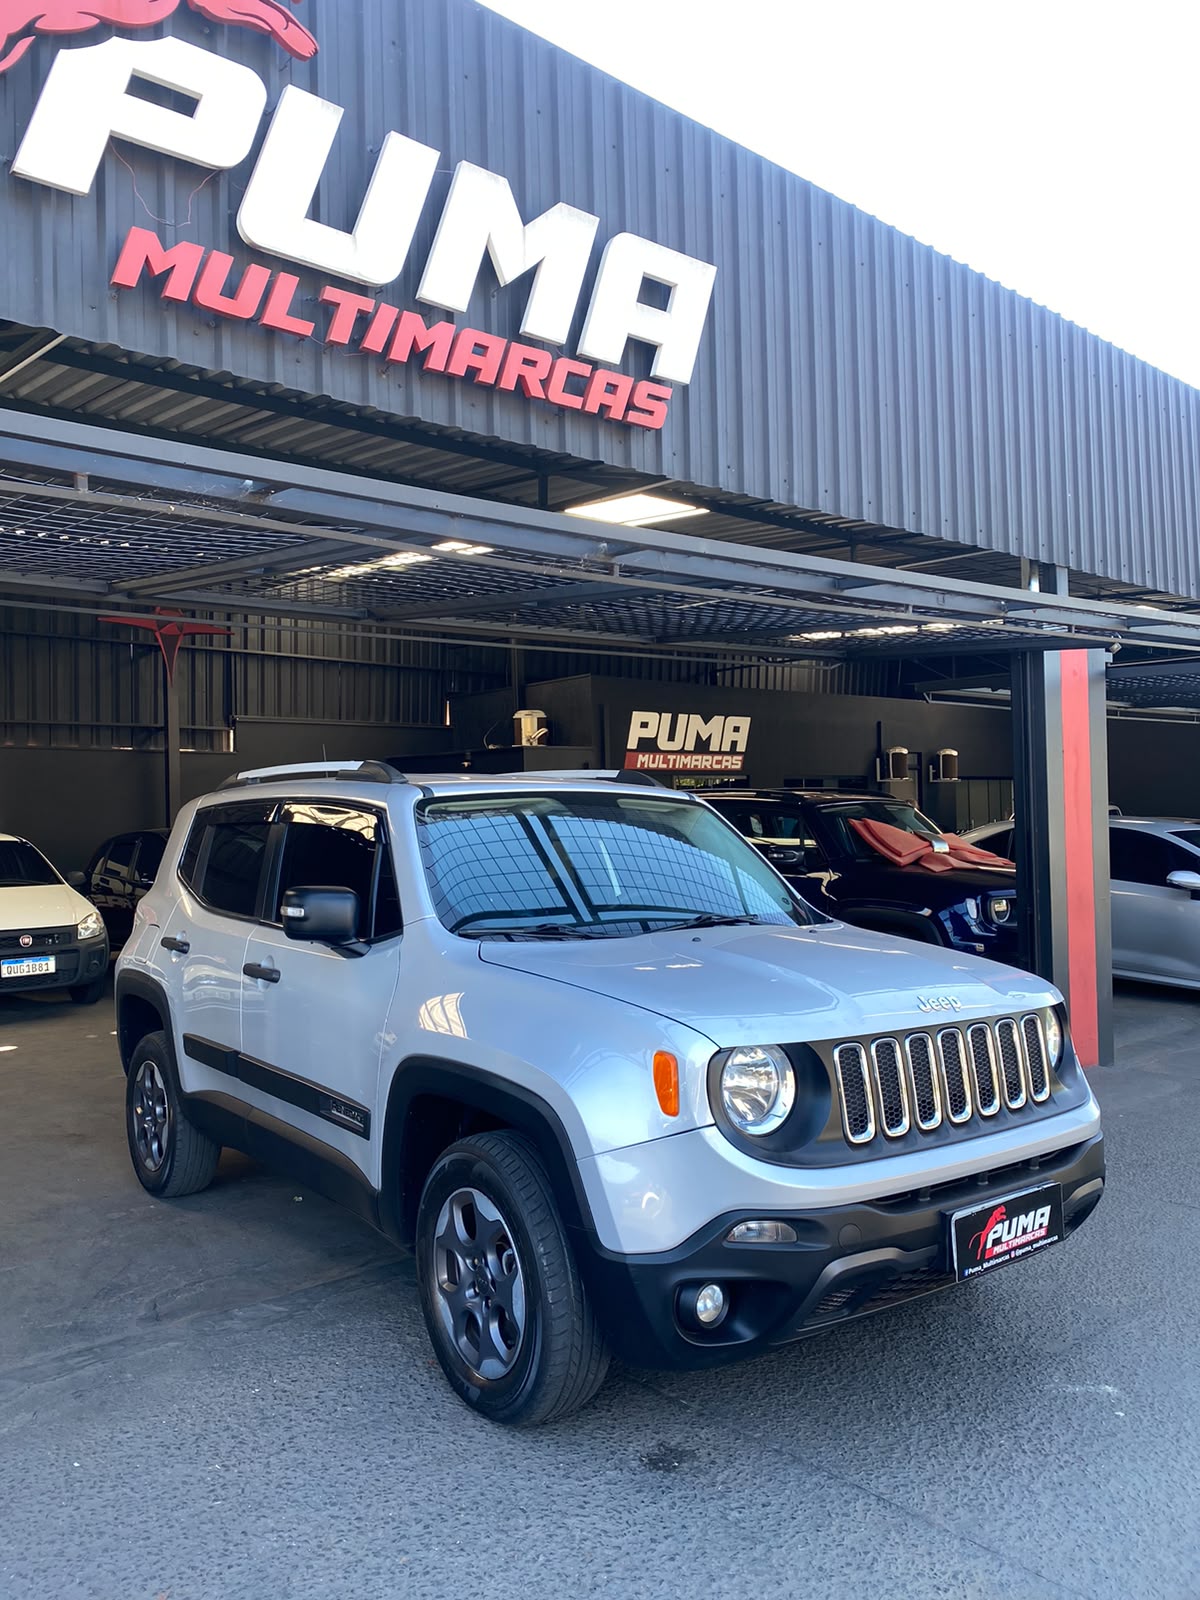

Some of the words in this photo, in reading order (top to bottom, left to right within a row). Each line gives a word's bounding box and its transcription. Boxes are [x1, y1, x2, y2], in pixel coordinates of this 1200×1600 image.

[11, 35, 718, 386] PUMA
[110, 225, 673, 430] MULTIMARCAS
[626, 711, 751, 752] PUMA
[637, 754, 742, 769] MULTIMARCAS
[6, 962, 50, 975] QUG1B81
[916, 995, 962, 1013] Jeep
[986, 1205, 1051, 1249] PUMA
[993, 1228, 1047, 1256] MULTIMARCAS
